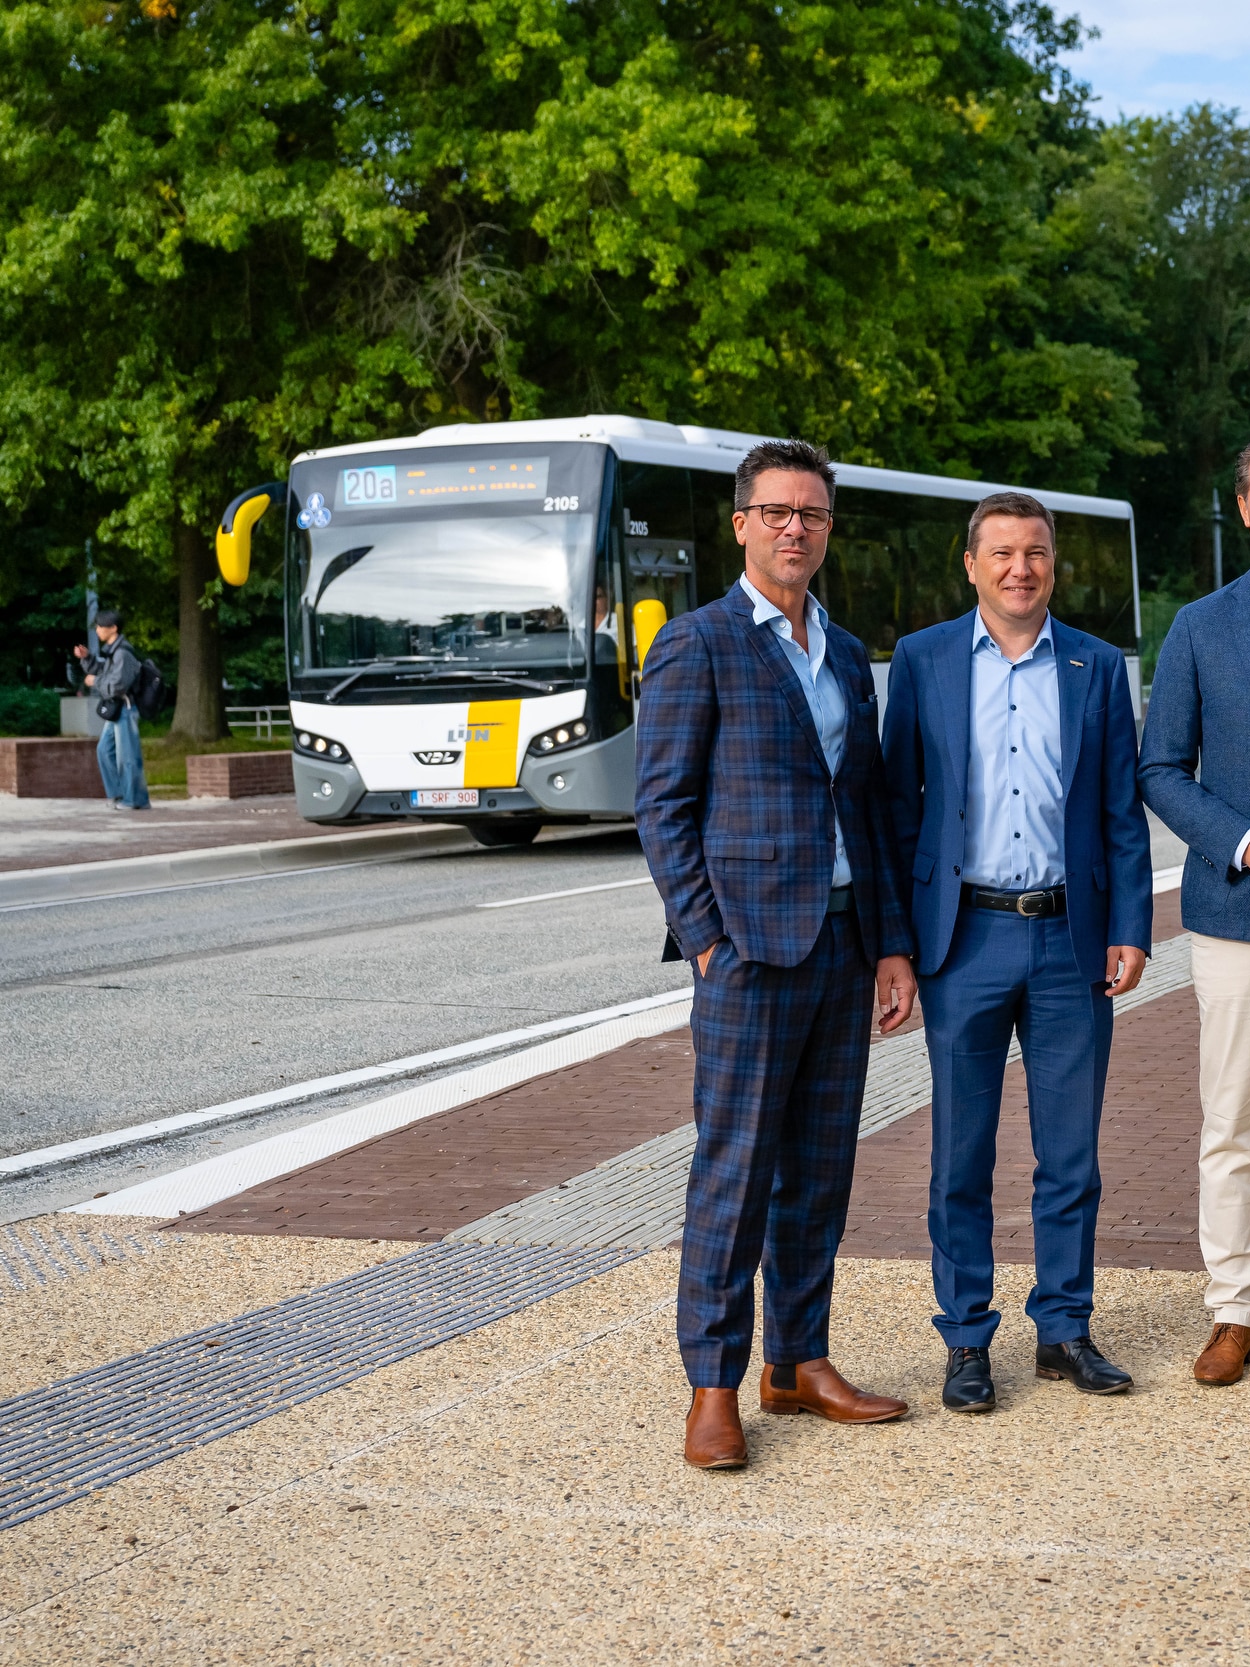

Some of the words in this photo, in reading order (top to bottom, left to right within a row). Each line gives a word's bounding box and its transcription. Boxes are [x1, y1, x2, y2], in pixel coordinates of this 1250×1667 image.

[347, 471, 393, 501] 20a
[543, 496, 579, 511] 2105
[629, 520, 649, 536] 2105
